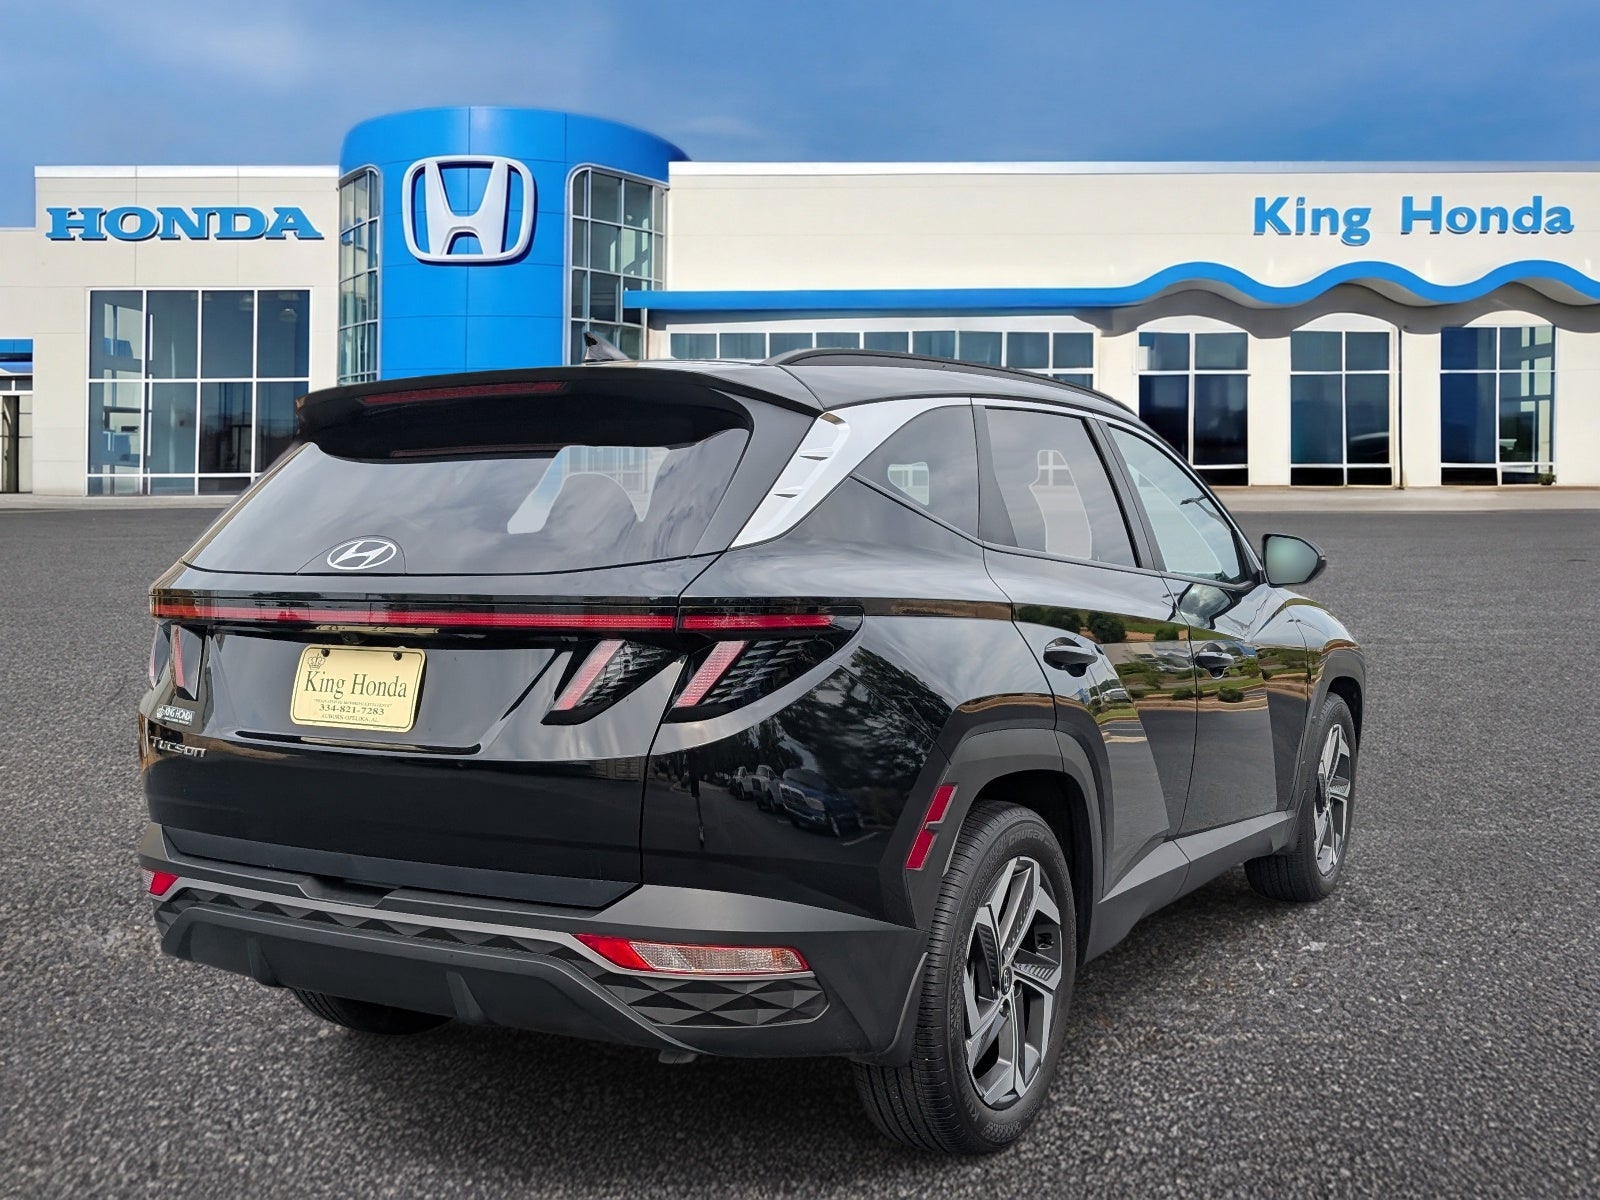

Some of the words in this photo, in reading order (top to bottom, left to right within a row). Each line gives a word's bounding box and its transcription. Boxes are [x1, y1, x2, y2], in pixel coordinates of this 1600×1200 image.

[46, 206, 325, 241] HONDA
[1253, 196, 1371, 246] King
[1401, 195, 1574, 235] Honda
[304, 671, 346, 699] King
[350, 673, 407, 697] Honda
[319, 704, 385, 715] 334-821-7283
